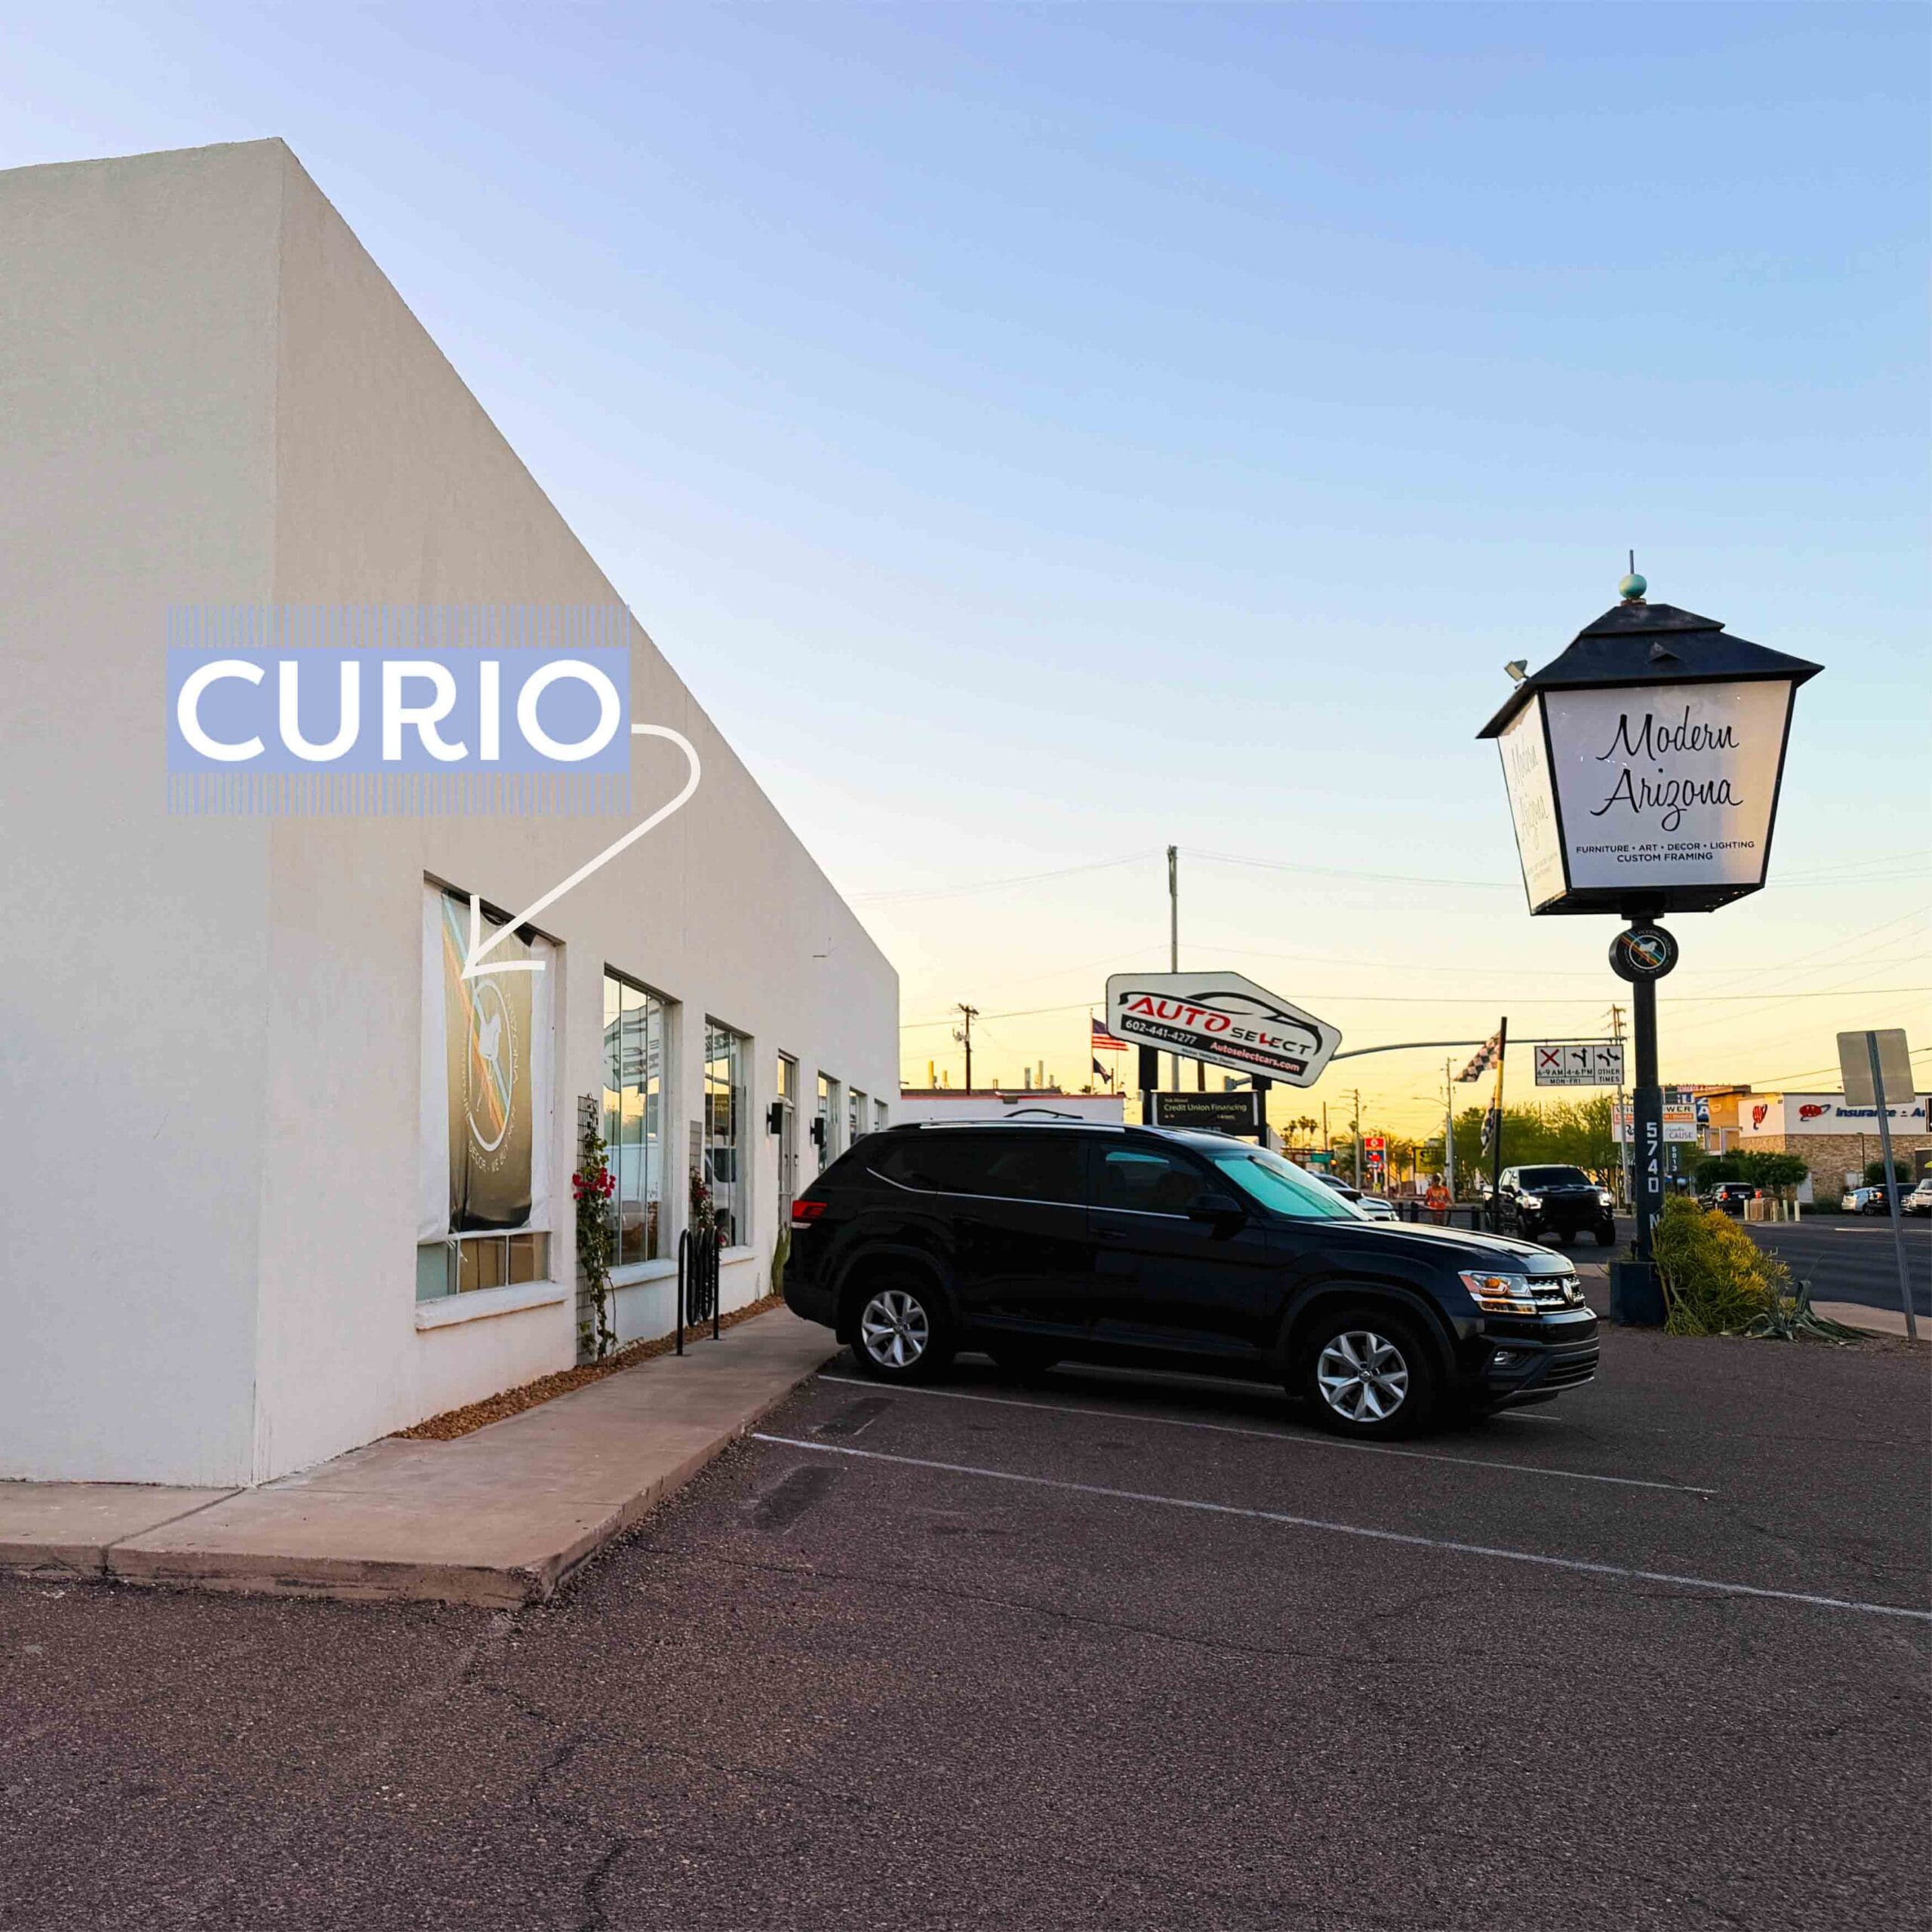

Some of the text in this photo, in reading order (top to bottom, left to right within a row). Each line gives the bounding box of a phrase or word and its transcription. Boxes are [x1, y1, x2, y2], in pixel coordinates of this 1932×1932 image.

[1595, 706, 1740, 761] Modern
[1590, 768, 1743, 832] Arizona
[1576, 841, 1755, 854] FURNITURE ART DECOR LIGHTING
[1617, 852, 1714, 863] CUSTOM FRAMING
[1128, 995, 1232, 1032] AUTO
[1125, 1020, 1198, 1045] 602-441-4277
[1230, 1027, 1312, 1055] SELECT
[1210, 1041, 1300, 1072] Autoselectcars.com
[1187, 1103, 1211, 1112] Union
[1211, 1103, 1247, 1112] Financing
[1646, 1121, 1660, 1193] 5740
